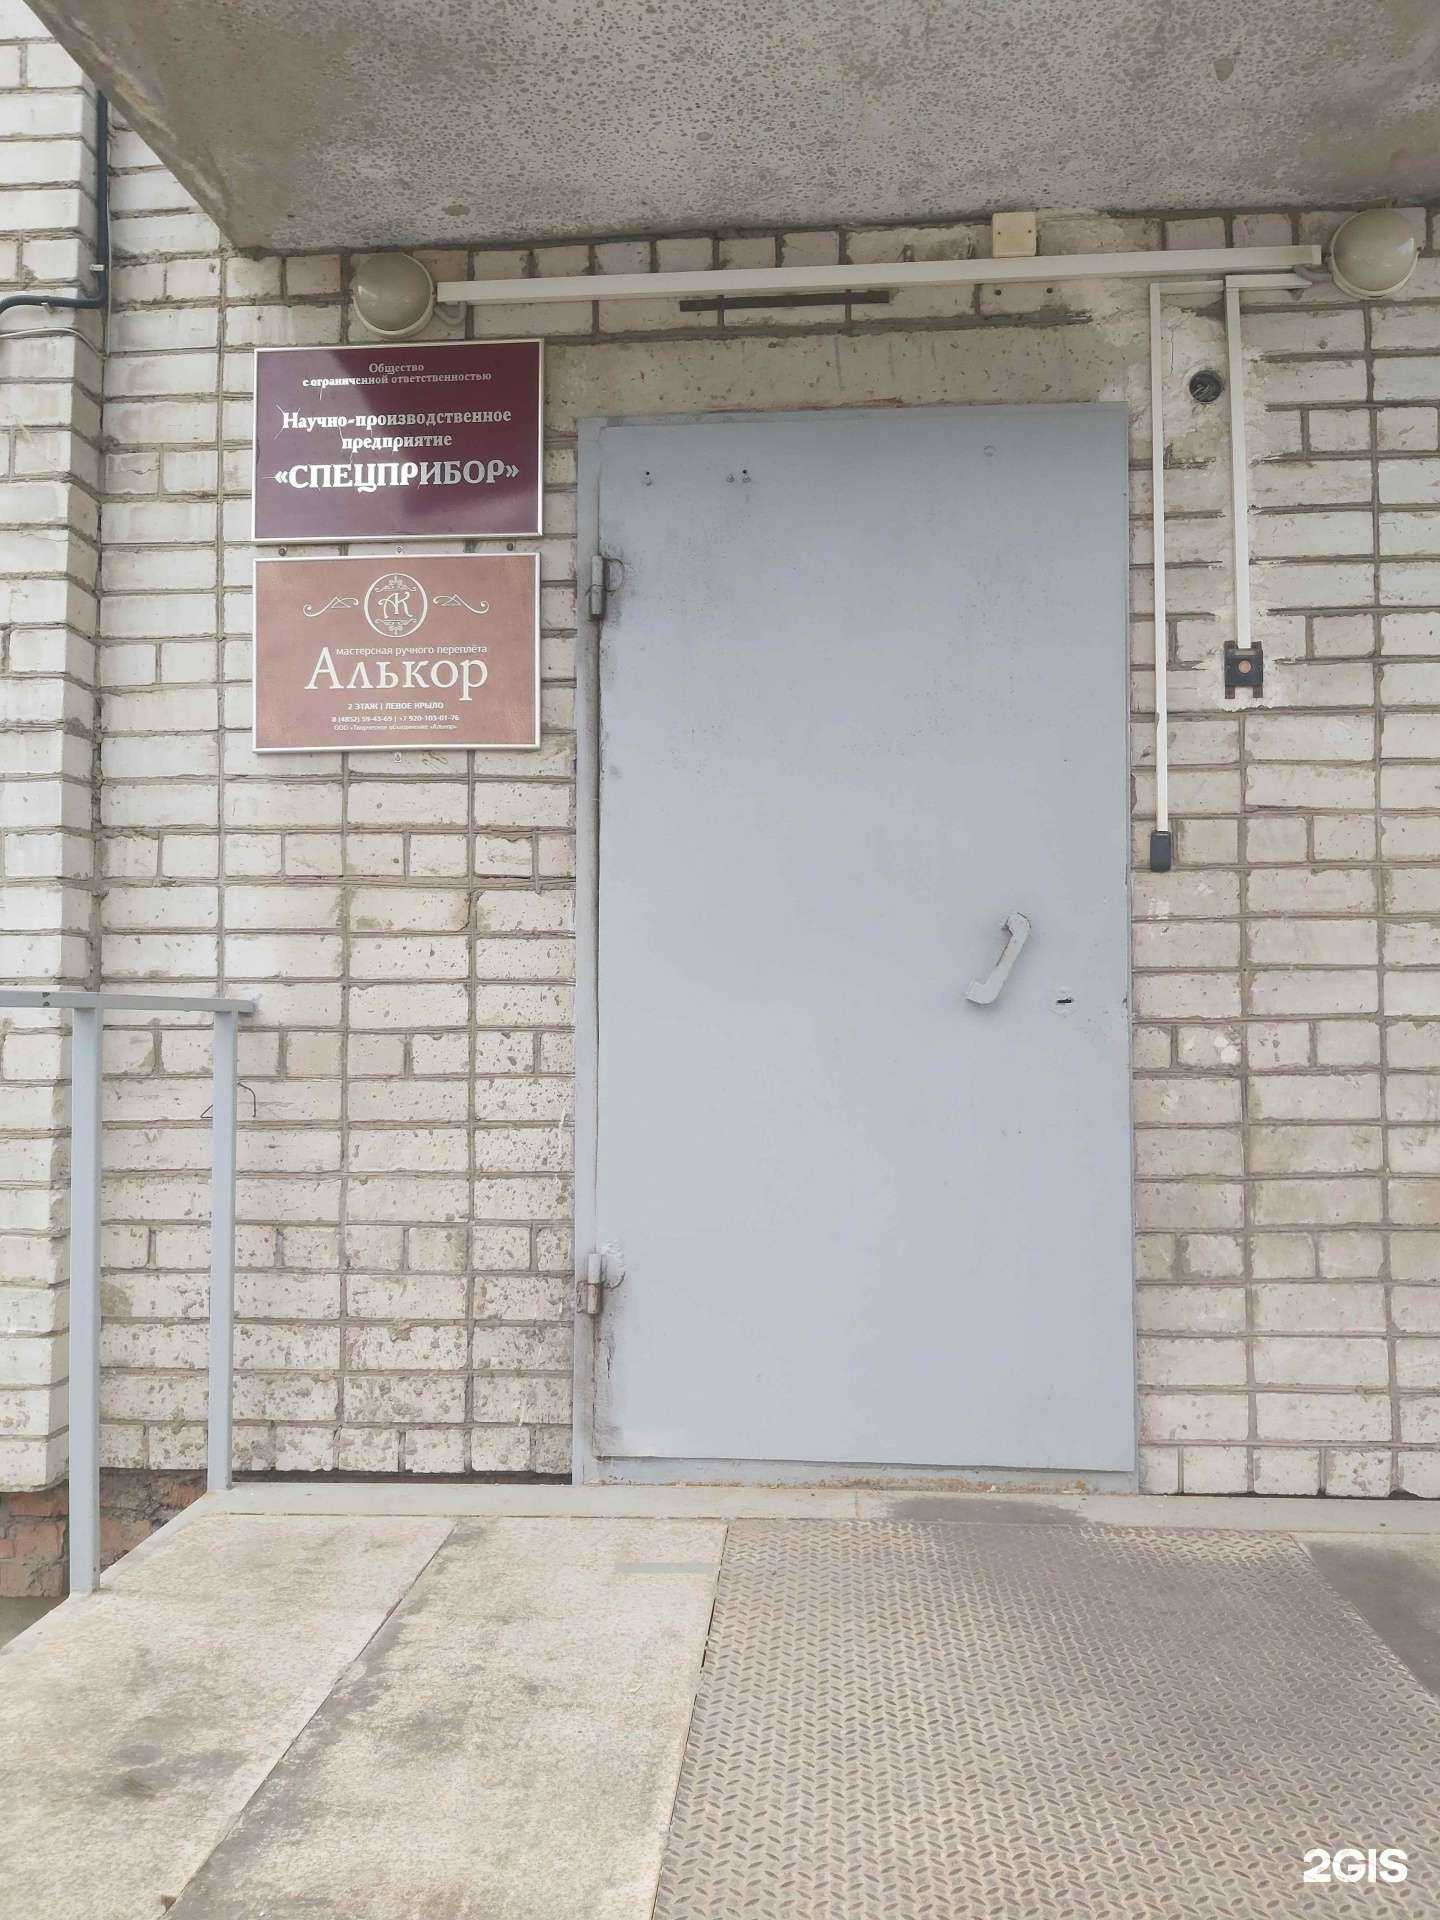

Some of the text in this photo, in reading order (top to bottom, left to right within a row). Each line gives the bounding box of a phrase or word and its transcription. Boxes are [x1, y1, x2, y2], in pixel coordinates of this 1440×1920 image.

[368, 362, 425, 375] Общество
[311, 373, 389, 388] ограниченной
[391, 371, 492, 385] ответственностью
[282, 409, 512, 432] Научно-производственное
[341, 433, 453, 453] предприятие
[274, 459, 520, 493] «СПЕЦПРИБОР»
[335, 647, 393, 656] мастерская
[395, 646, 434, 657] ручного
[304, 646, 488, 701] Алькор
[354, 703, 378, 711] ЭТАЖ
[385, 702, 413, 710] ЛЕВОЕ
